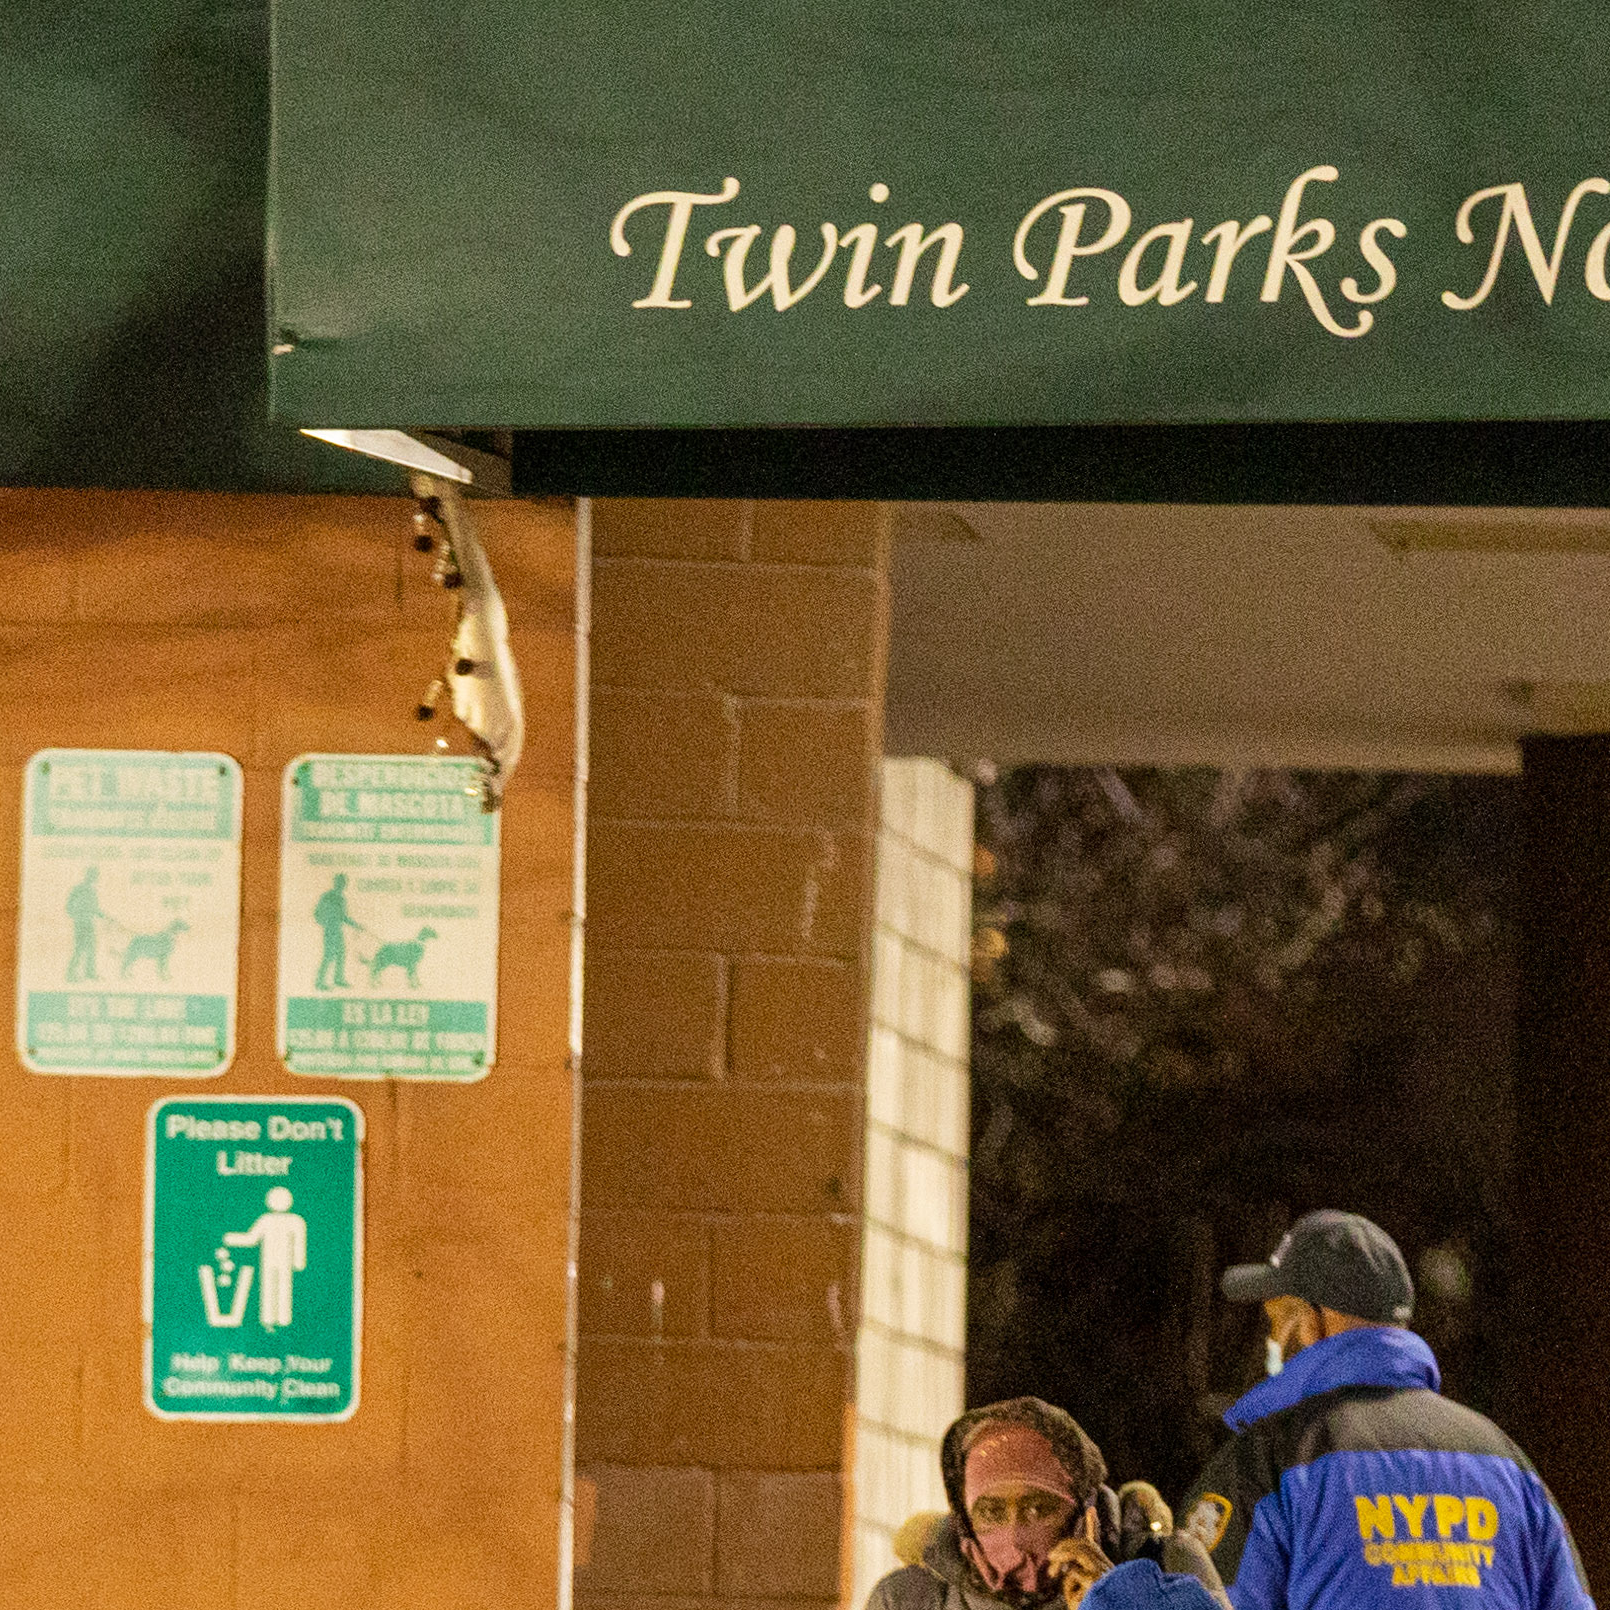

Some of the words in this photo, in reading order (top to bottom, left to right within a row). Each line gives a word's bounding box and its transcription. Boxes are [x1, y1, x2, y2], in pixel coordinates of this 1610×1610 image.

[611, 177, 970, 312] Twin
[1013, 165, 1407, 339] Parks
[165, 1113, 262, 1141] Please
[267, 1115, 344, 1141] Don't
[216, 1150, 293, 1176] Litter
[170, 1353, 220, 1375] Help
[228, 1353, 282, 1374] Keep
[161, 1376, 278, 1400] Community
[281, 1378, 341, 1399] Clean
[1354, 1494, 1499, 1541] NYPD
